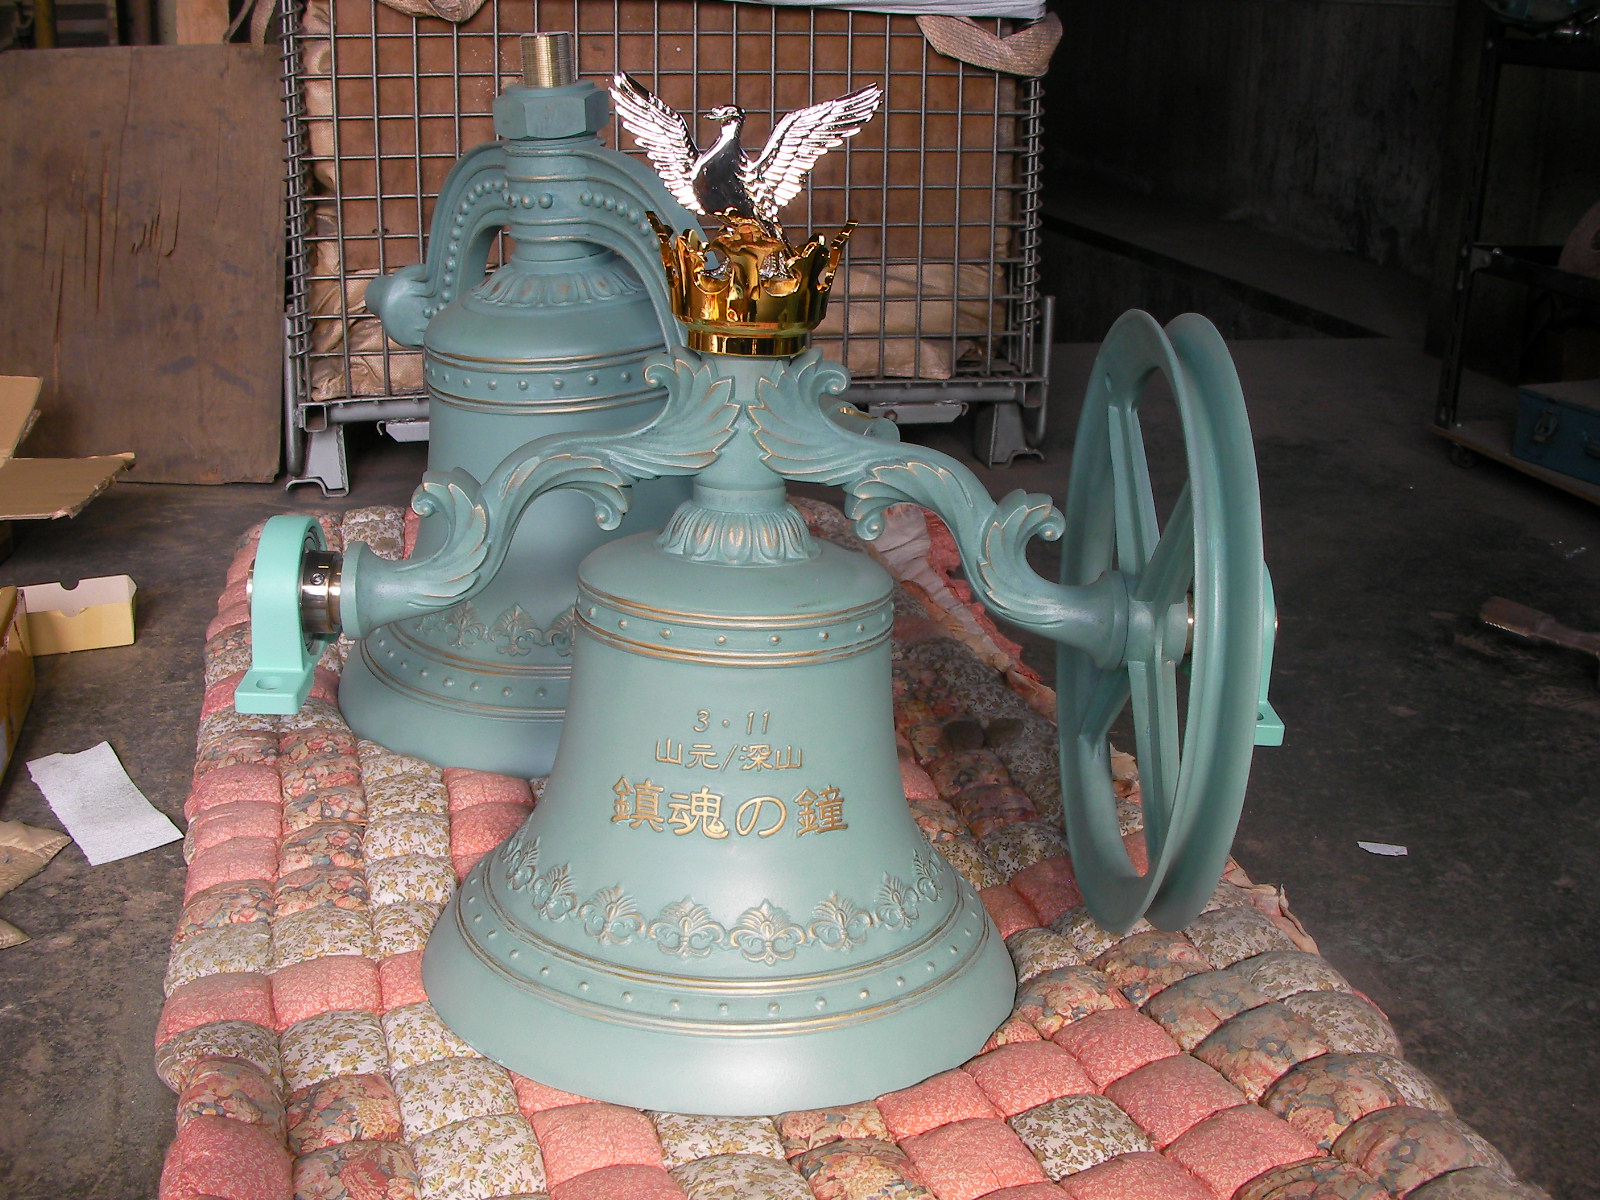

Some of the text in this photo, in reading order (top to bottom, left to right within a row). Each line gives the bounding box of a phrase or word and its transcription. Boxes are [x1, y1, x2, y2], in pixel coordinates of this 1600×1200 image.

[655, 738, 803, 772] 山元/深山
[611, 776, 848, 840] 鎮魂の鐘
